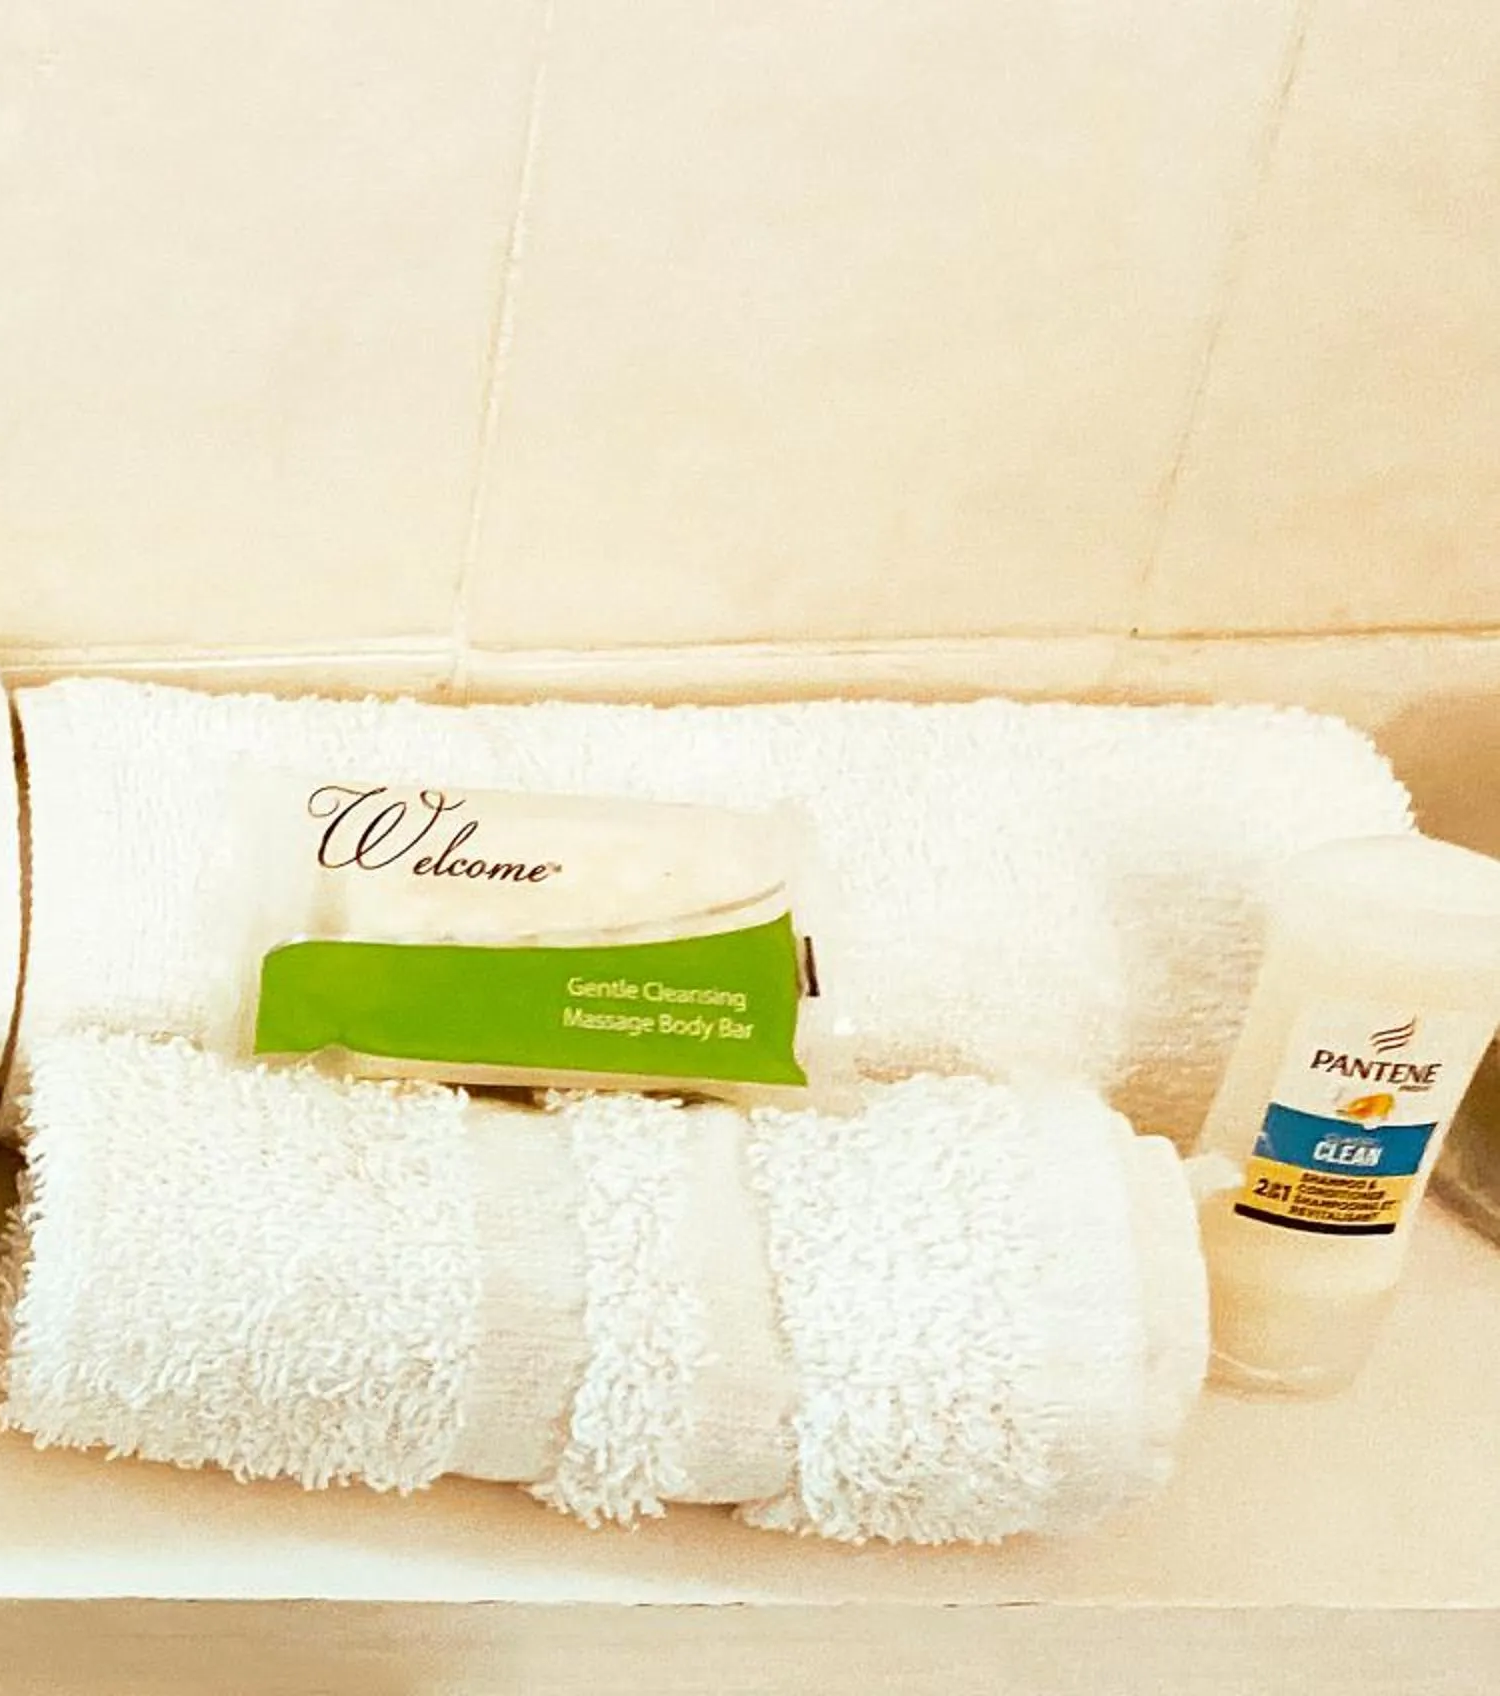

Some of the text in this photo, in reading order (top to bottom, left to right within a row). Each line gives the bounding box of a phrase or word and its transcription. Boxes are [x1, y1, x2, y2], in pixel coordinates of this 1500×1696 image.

[307, 785, 550, 883] Welcome
[567, 977, 748, 1013] Gentle Cleansing
[563, 1006, 755, 1042] Massage Body Bar
[1310, 1049, 1442, 1084] PANTENE
[1313, 1141, 1383, 1166] CLEAN
